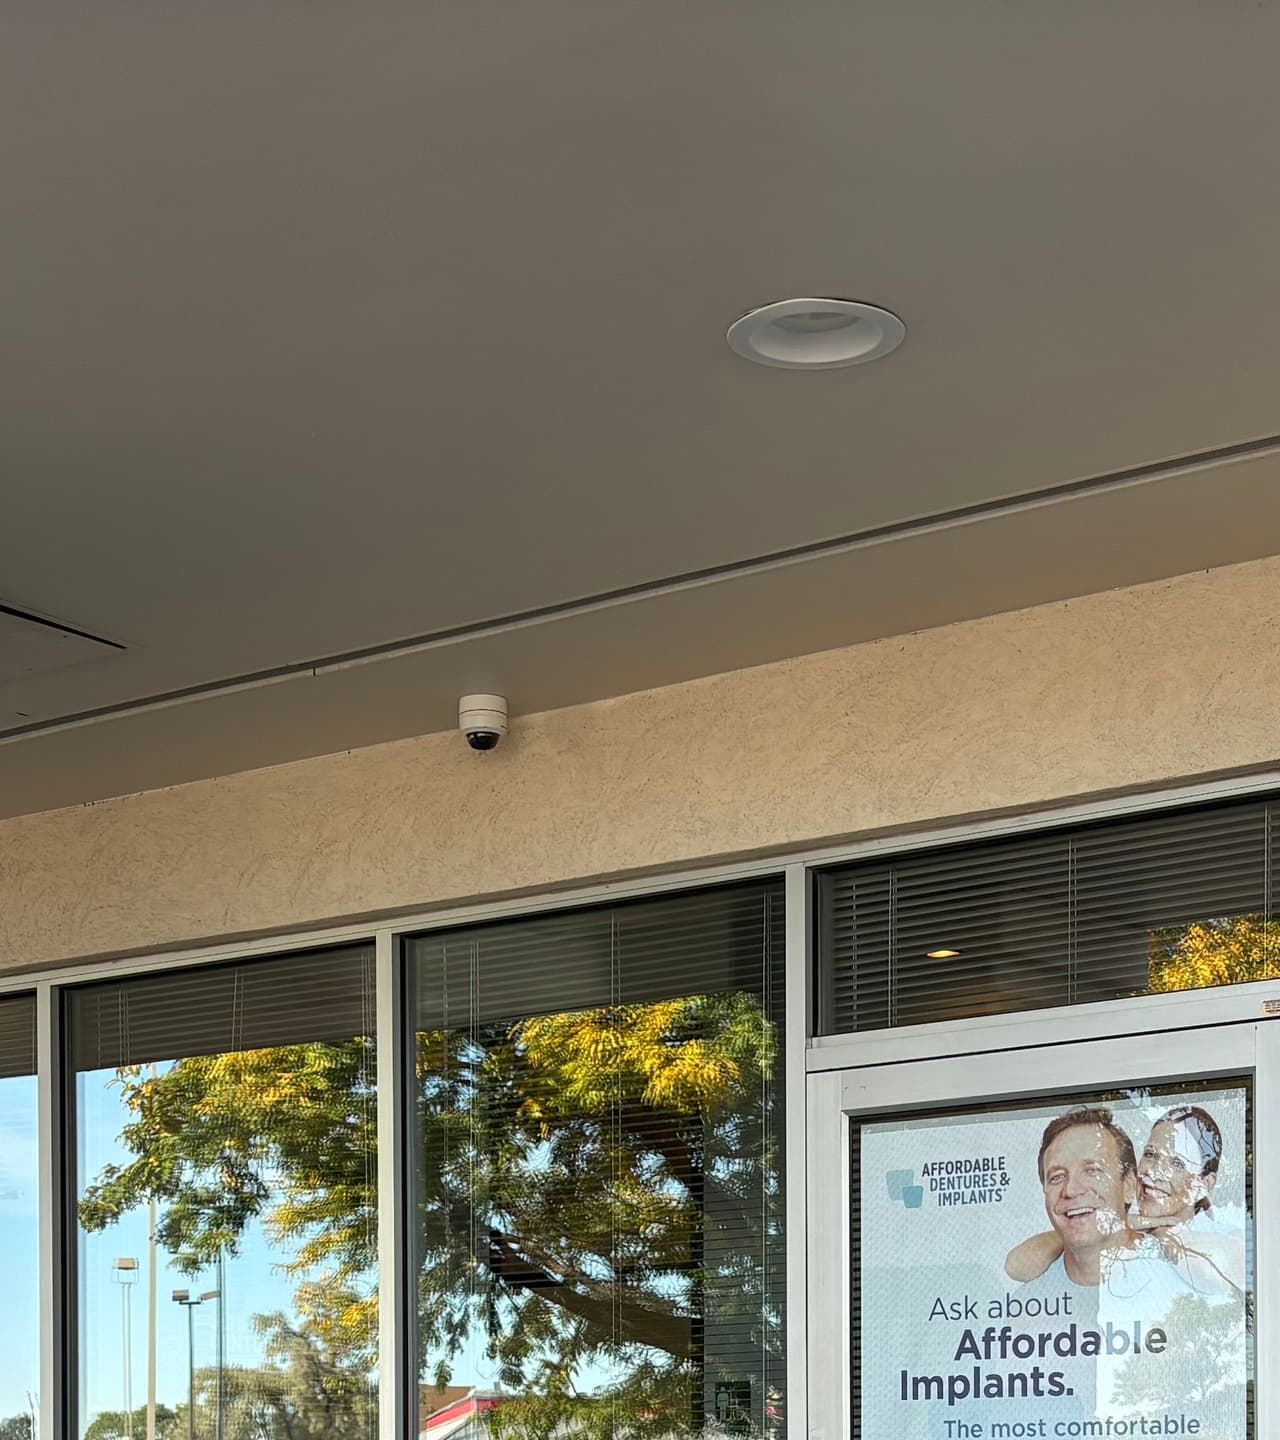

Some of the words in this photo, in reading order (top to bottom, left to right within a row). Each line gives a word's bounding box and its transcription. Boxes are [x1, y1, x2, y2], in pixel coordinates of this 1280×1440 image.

[921, 1156, 1006, 1177] AFFORDABLE
[929, 1173, 997, 1192] DENTURES
[999, 1171, 1011, 1187] &
[938, 1188, 1003, 1207] IMPLANTS
[928, 1295, 979, 1322] Ask
[987, 1291, 1073, 1319] about
[953, 1320, 1168, 1361] Affordable
[900, 1365, 1074, 1406] Implants.
[943, 1419, 983, 1439] The
[991, 1418, 1047, 1438] most
[1053, 1414, 1201, 1437] comfortable
